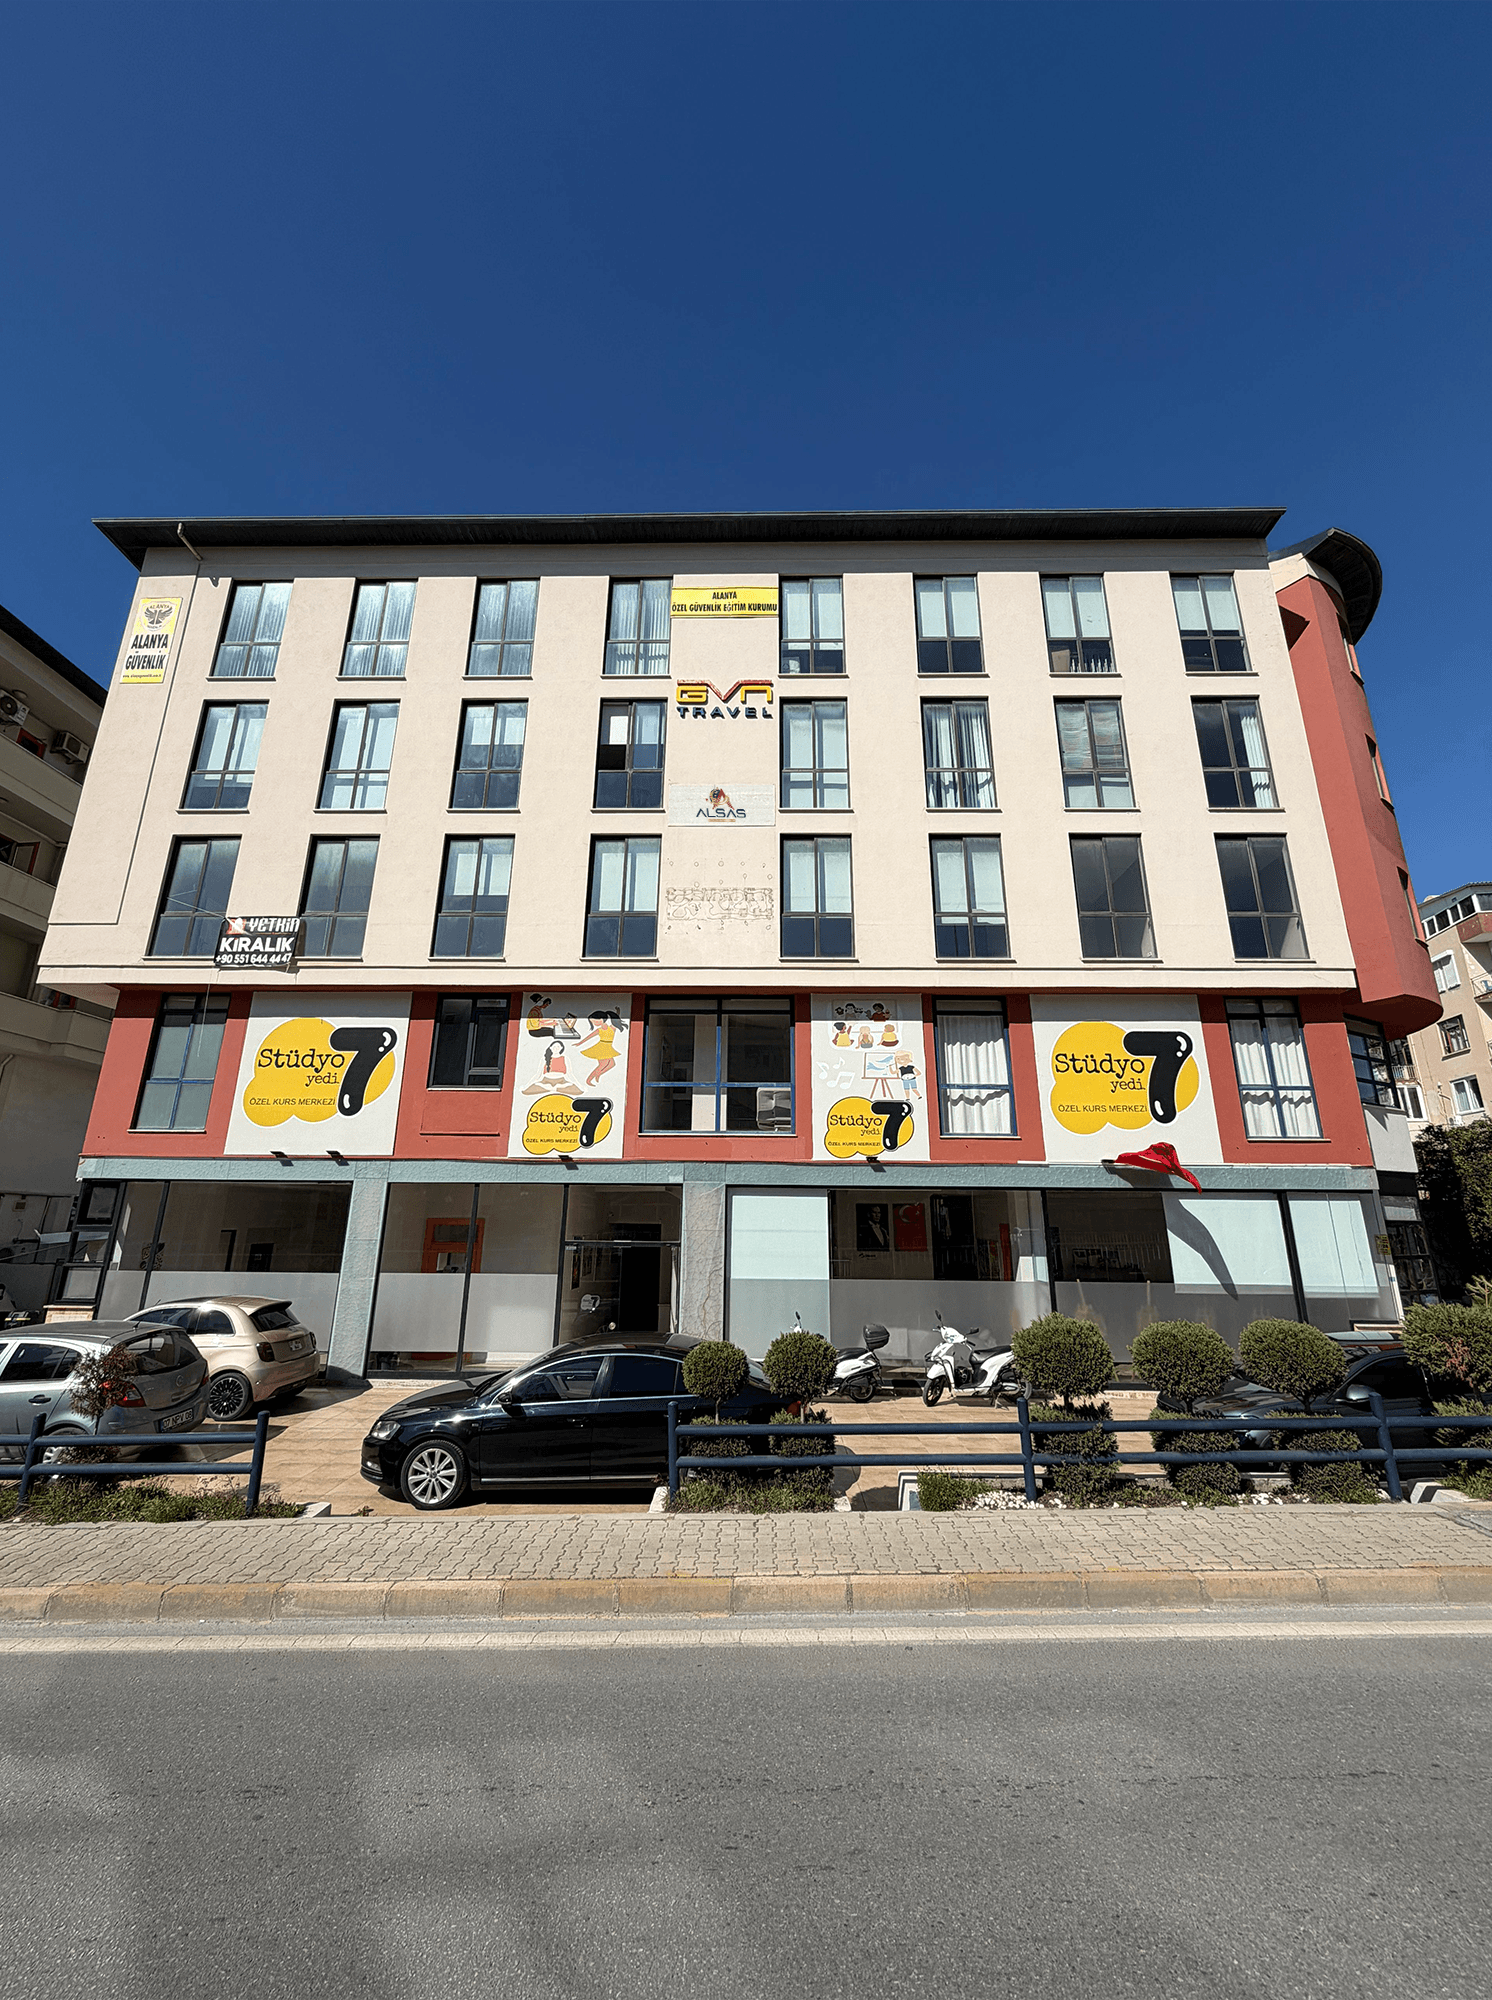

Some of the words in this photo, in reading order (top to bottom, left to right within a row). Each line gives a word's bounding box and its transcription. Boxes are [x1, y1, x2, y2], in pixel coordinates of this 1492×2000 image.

[712, 591, 737, 599] ALANYA
[672, 602, 687, 611] ÖZEL
[689, 602, 721, 611] GÜVENLİK
[724, 601, 746, 611] EĞİTİM
[748, 603, 777, 611] KURUMU
[131, 634, 169, 649] ALANYA
[126, 650, 166, 670] GÜVENLİK
[676, 706, 773, 719] TRAVEL
[696, 808, 746, 818] ALSAS
[216, 954, 233, 963] +90
[234, 954, 249, 963] 551
[250, 954, 267, 963] 644
[258, 1048, 345, 1073] Stüdyo
[329, 1027, 398, 1117] 7
[305, 1072, 339, 1087] yedi
[1055, 1053, 1145, 1079] Stüdyo
[1123, 1031, 1193, 1124] 7
[1110, 1078, 1145, 1093] yedi
[298, 1097, 336, 1105] MERKEZİ
[1058, 1104, 1081, 1112] ÖZEL
[1083, 1104, 1107, 1112] KURS
[1109, 1103, 1147, 1112] MERKEZİ
[530, 1112, 581, 1126] Stüdyo
[572, 1099, 611, 1147] 7
[830, 1114, 882, 1128] Stüdyo
[871, 1102, 912, 1150] 7
